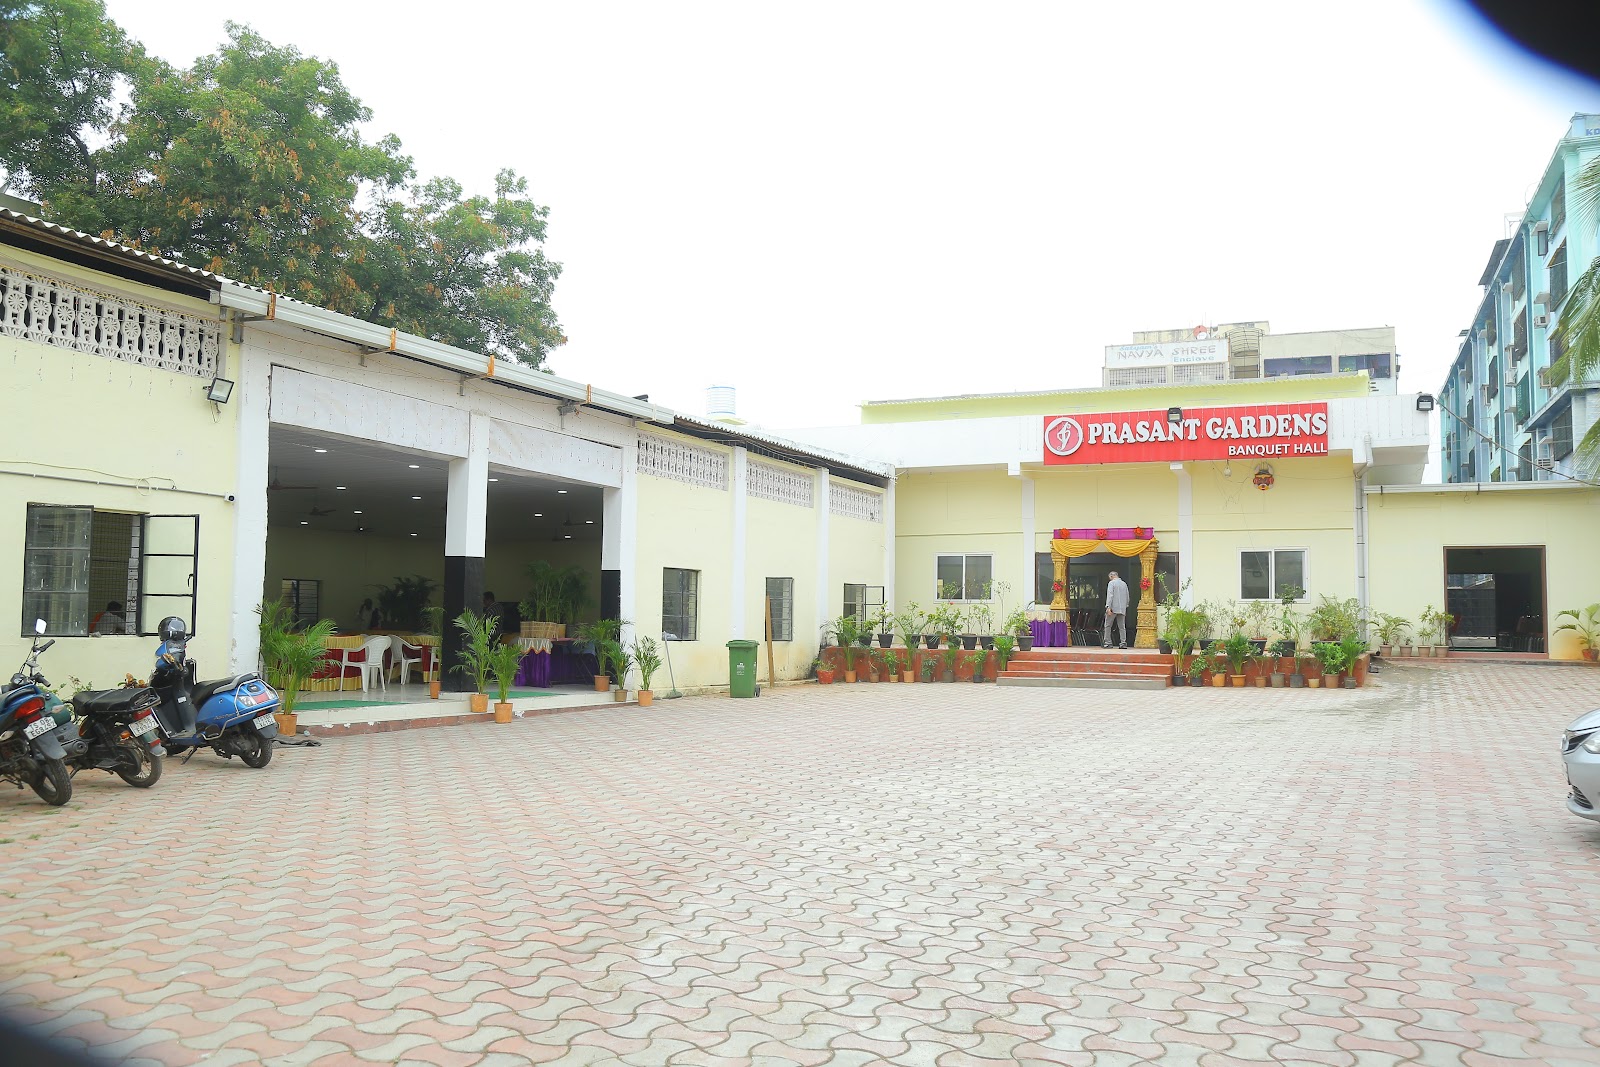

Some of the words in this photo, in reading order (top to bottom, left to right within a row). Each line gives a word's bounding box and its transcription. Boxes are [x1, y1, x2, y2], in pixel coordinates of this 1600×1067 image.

[1118, 349, 1164, 360] NAVYA
[1172, 345, 1216, 356] SHREE
[1173, 355, 1215, 363] Enclave
[1087, 418, 1201, 444] PRASANT
[1205, 412, 1328, 440] GARDENS
[1228, 443, 1291, 456] BANQUET
[1293, 442, 1328, 454] HALL
